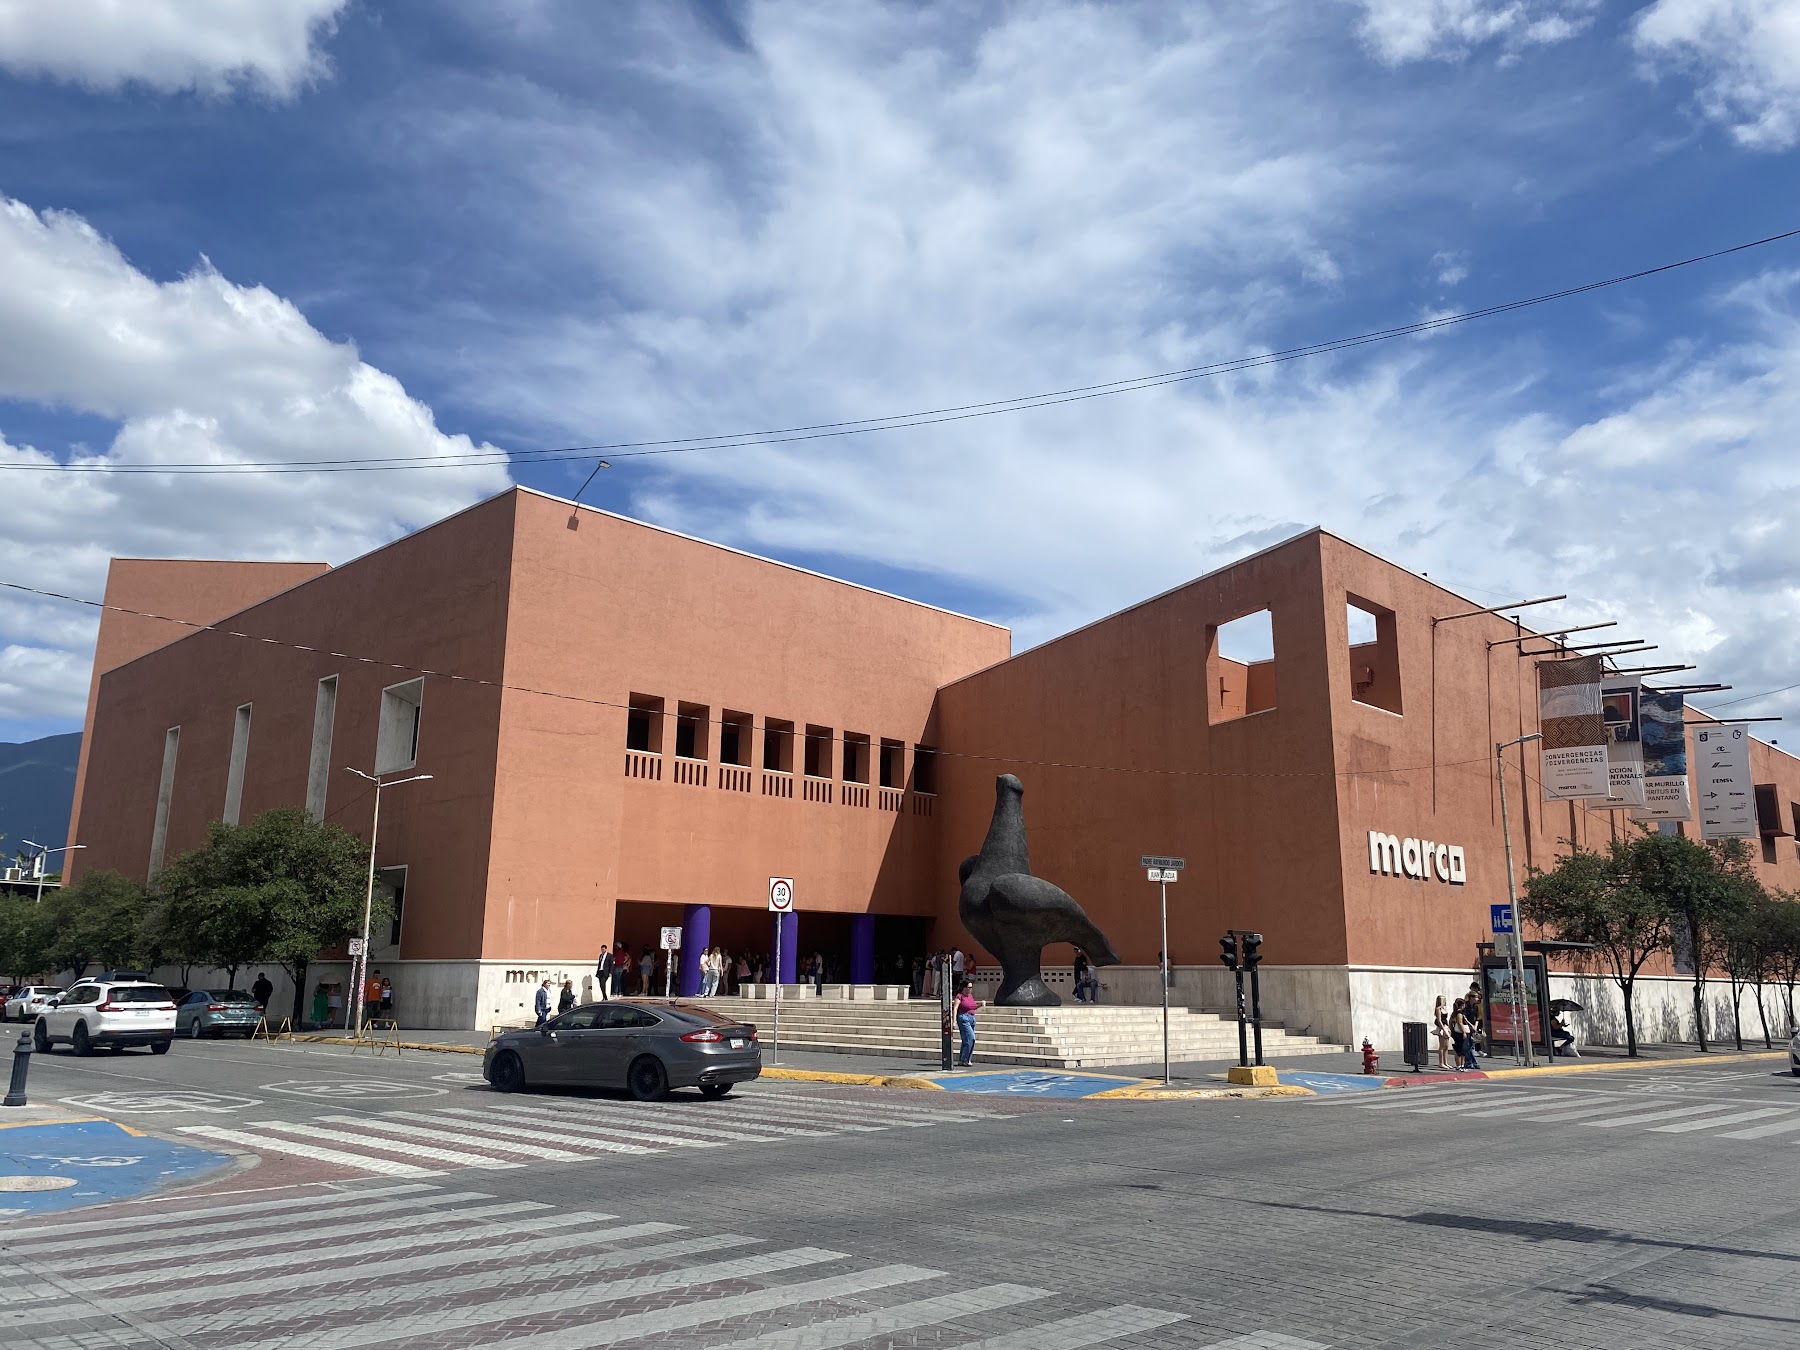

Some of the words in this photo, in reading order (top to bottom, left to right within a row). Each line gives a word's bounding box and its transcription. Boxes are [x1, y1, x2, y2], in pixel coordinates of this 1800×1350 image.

[1545, 751, 1603, 760] CONVERGENCIAS
[1368, 831, 1466, 884] marco
[777, 887, 786, 897] 30
